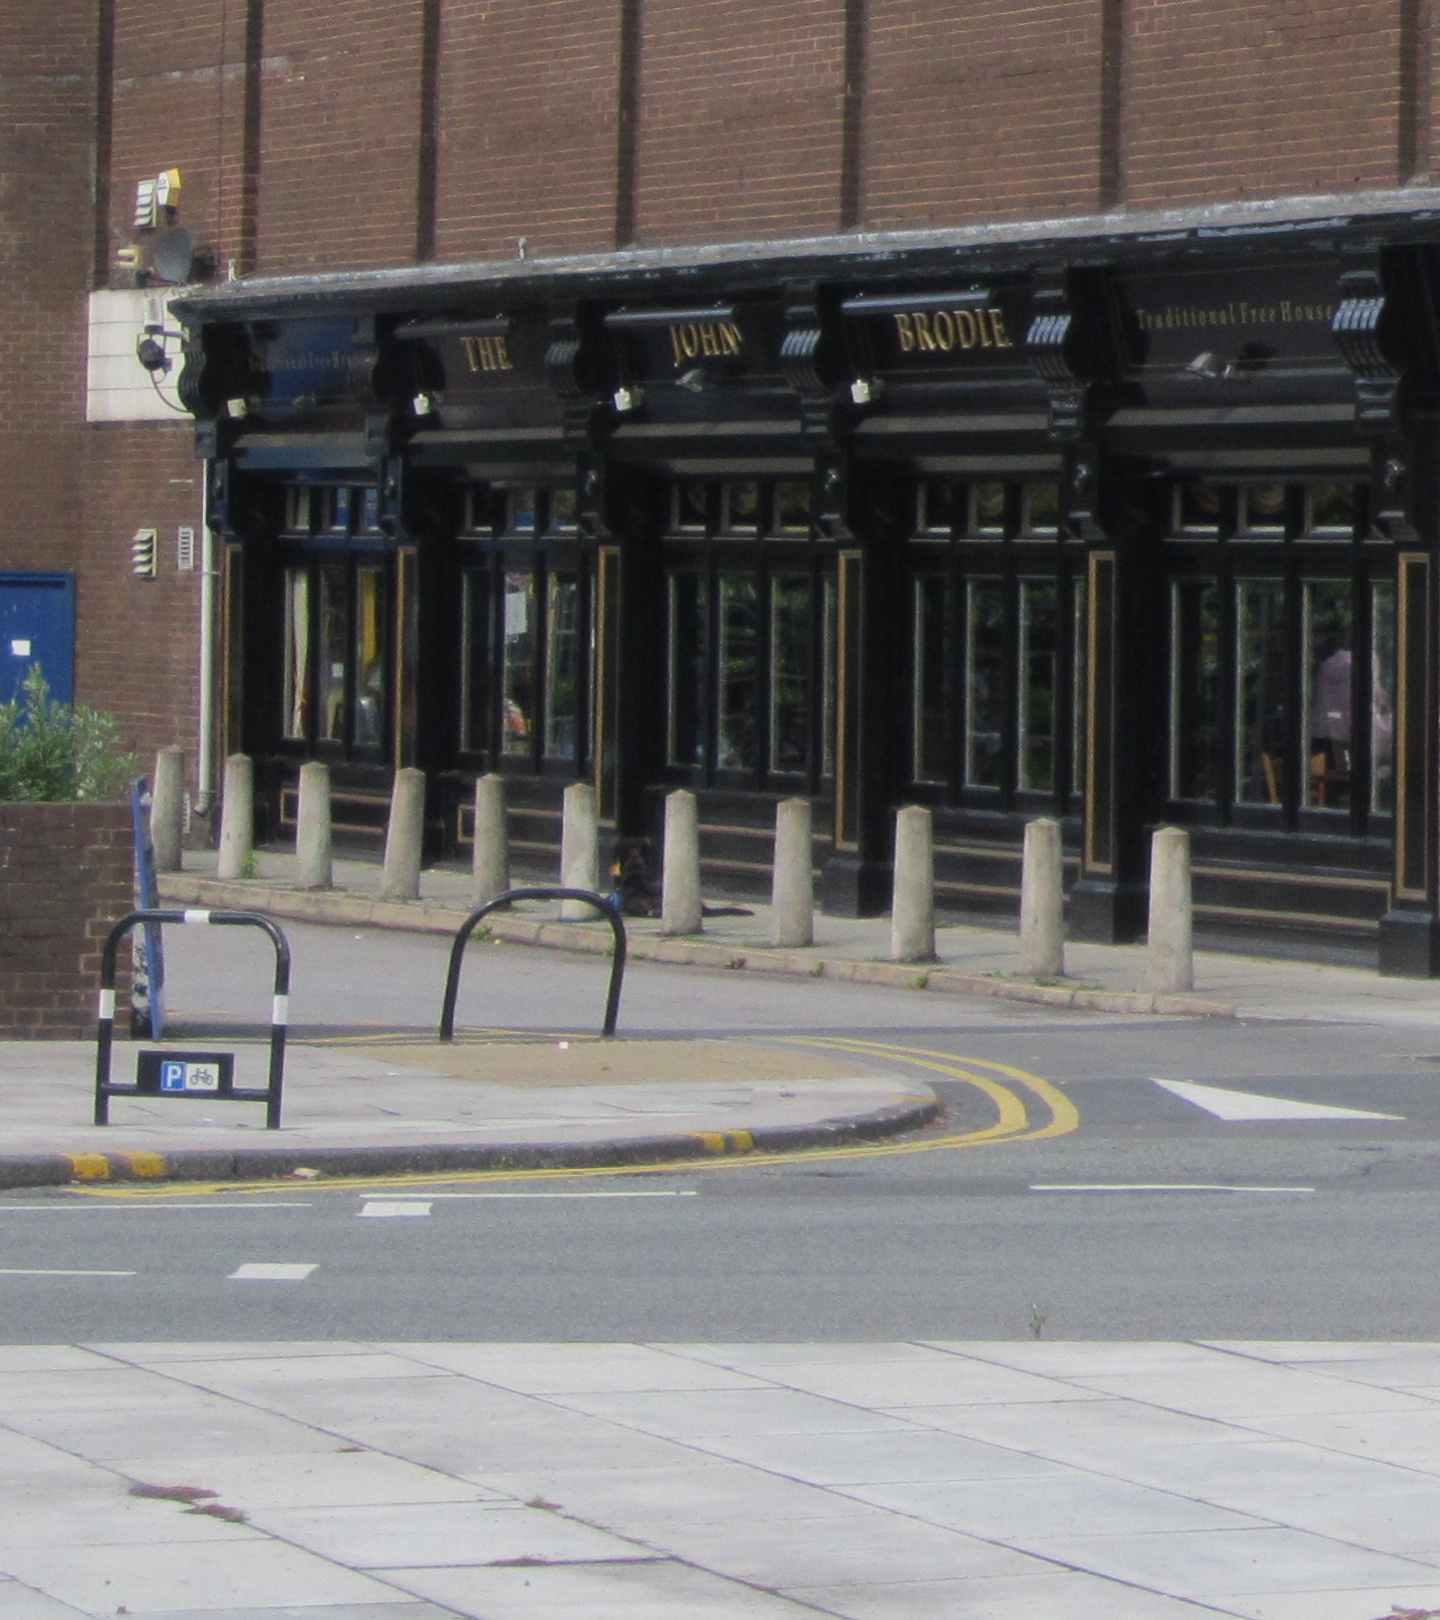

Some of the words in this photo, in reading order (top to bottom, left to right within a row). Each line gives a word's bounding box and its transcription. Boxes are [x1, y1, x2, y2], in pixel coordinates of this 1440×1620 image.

[893, 308, 1014, 352] BRODIE
[1136, 303, 1236, 330] Traditional
[1238, 302, 1276, 325] Free
[459, 335, 513, 372] THE
[669, 323, 743, 368] JOHN
[166, 1064, 182, 1088] P
